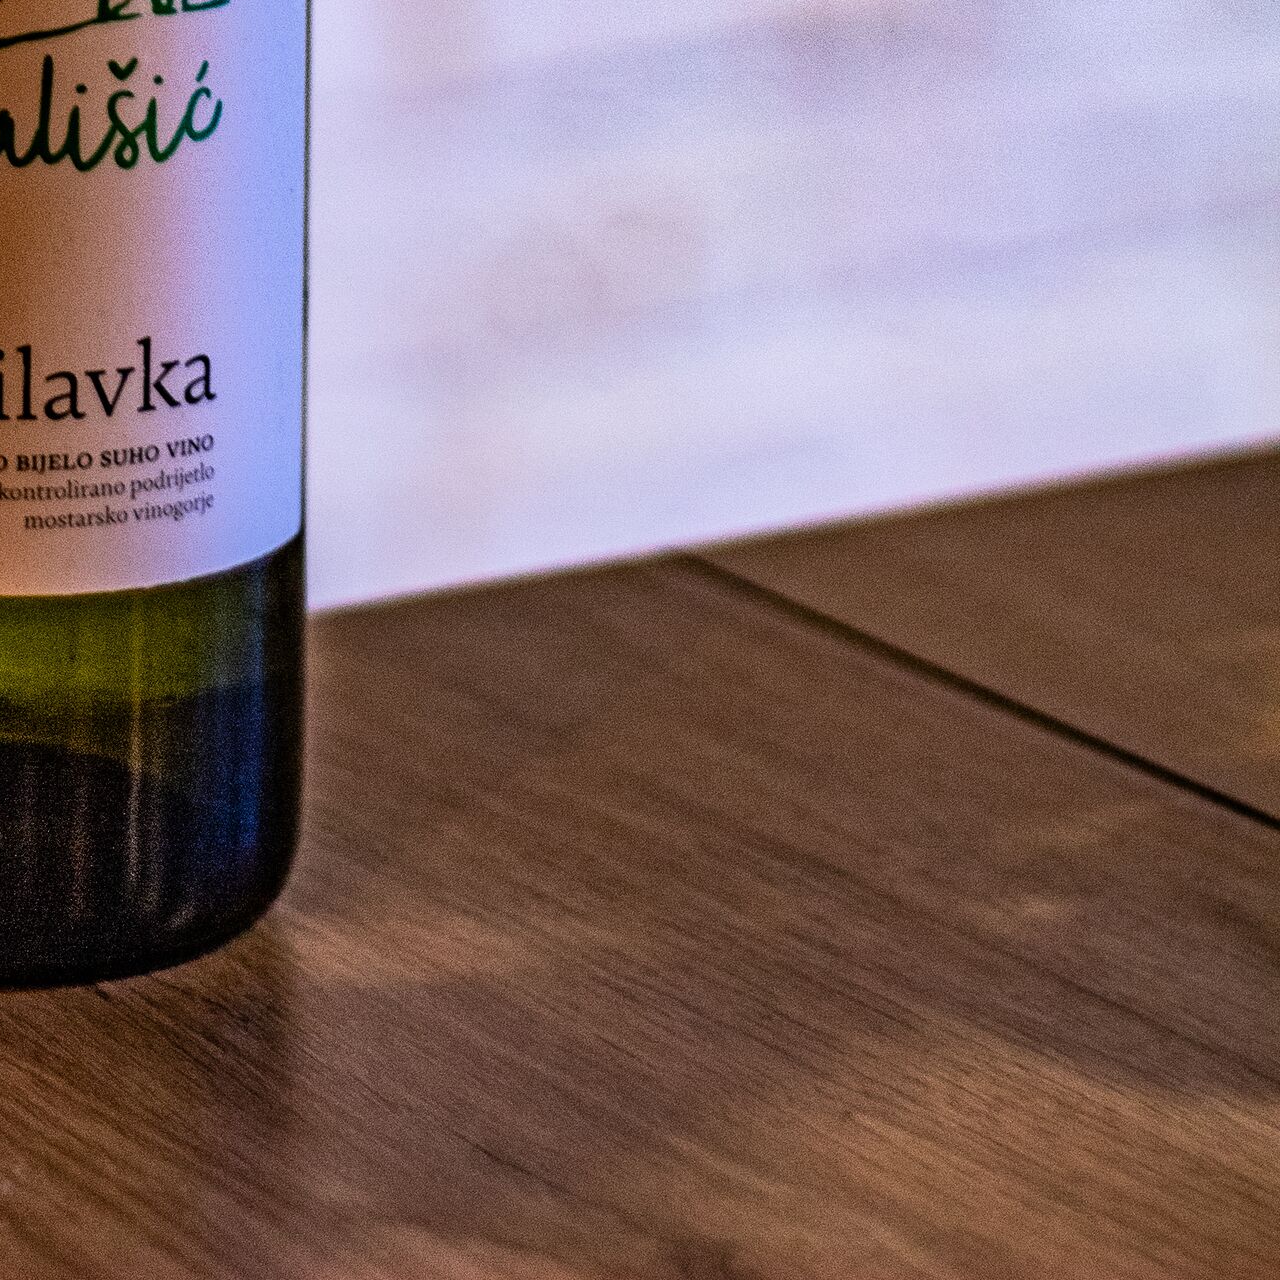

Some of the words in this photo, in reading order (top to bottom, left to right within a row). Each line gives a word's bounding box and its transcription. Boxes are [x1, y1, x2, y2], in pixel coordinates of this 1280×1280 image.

[17, 451, 93, 474] BIJELO
[100, 444, 160, 467] SUHO
[168, 434, 215, 459] VINO
[130, 463, 215, 499] podrijetlo
[24, 506, 129, 530] mostarsko
[133, 492, 215, 523] vinogorje
